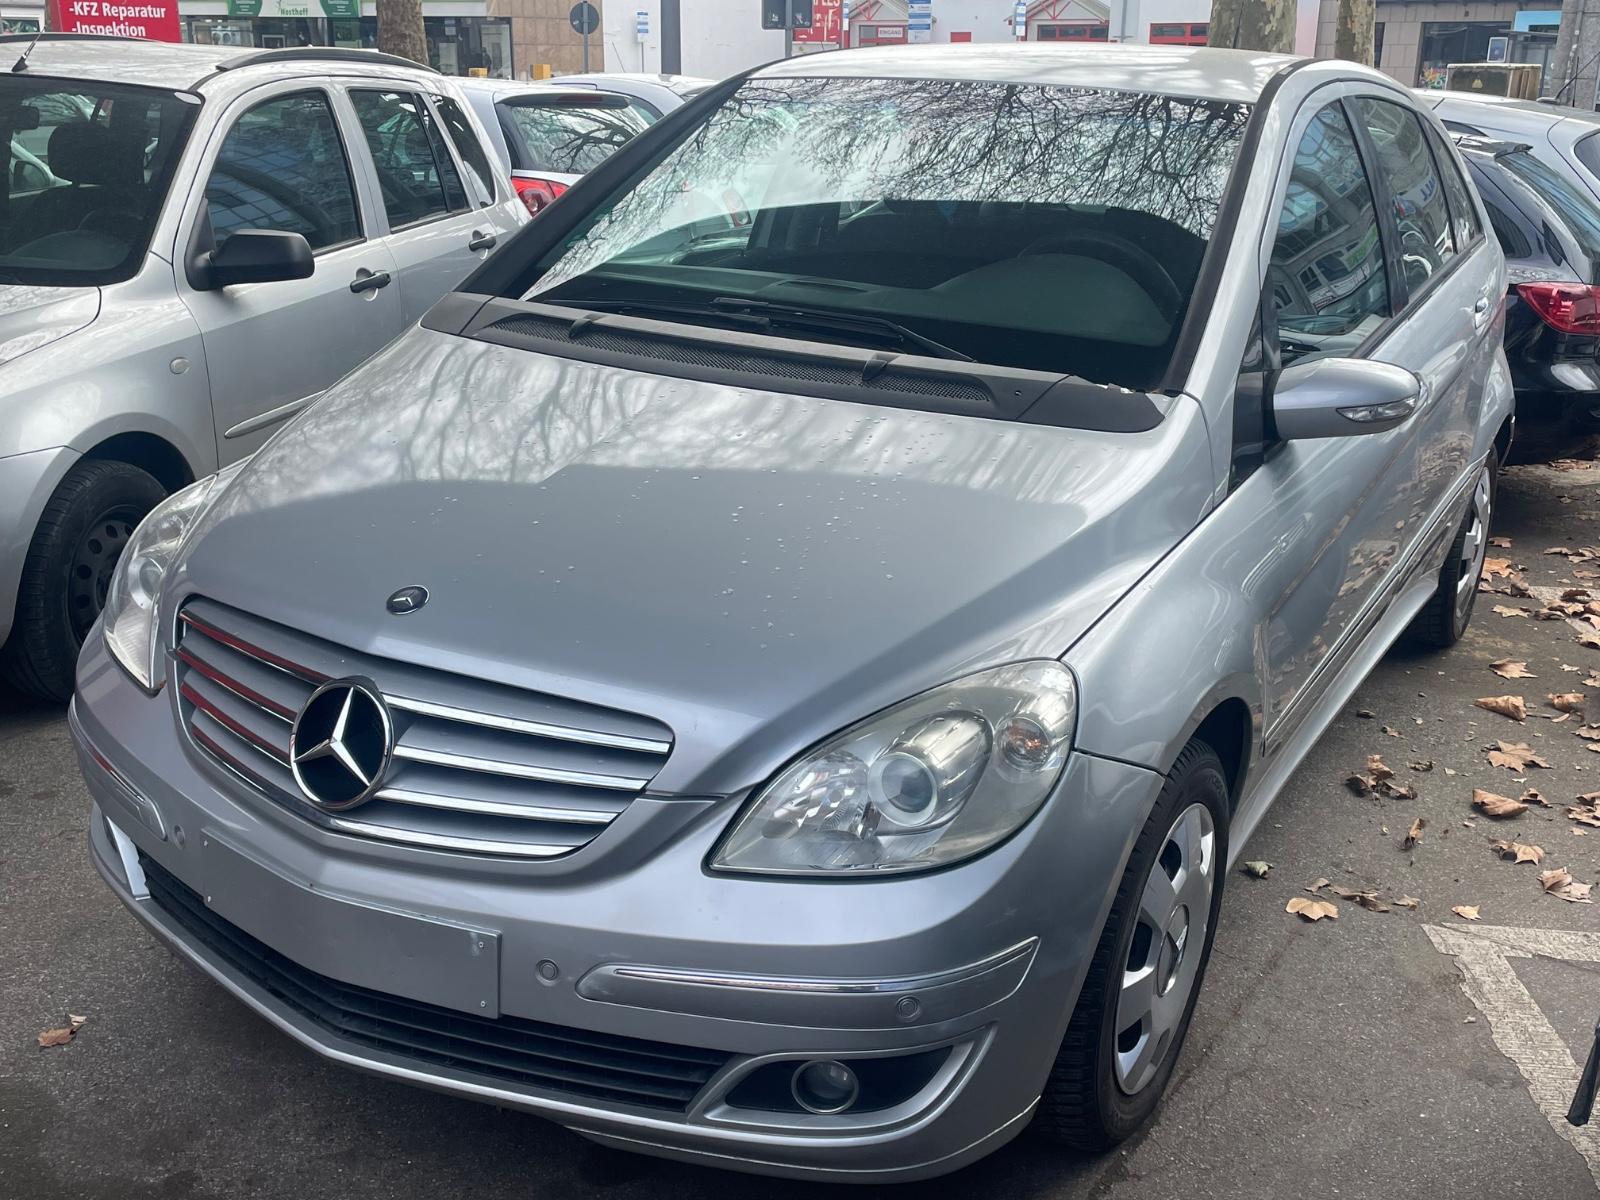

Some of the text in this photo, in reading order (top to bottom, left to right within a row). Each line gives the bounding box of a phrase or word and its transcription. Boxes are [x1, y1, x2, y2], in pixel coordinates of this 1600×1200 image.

[69, 2, 166, 21] -KFZ Reparatur
[72, 21, 146, 37] -Inspektion
